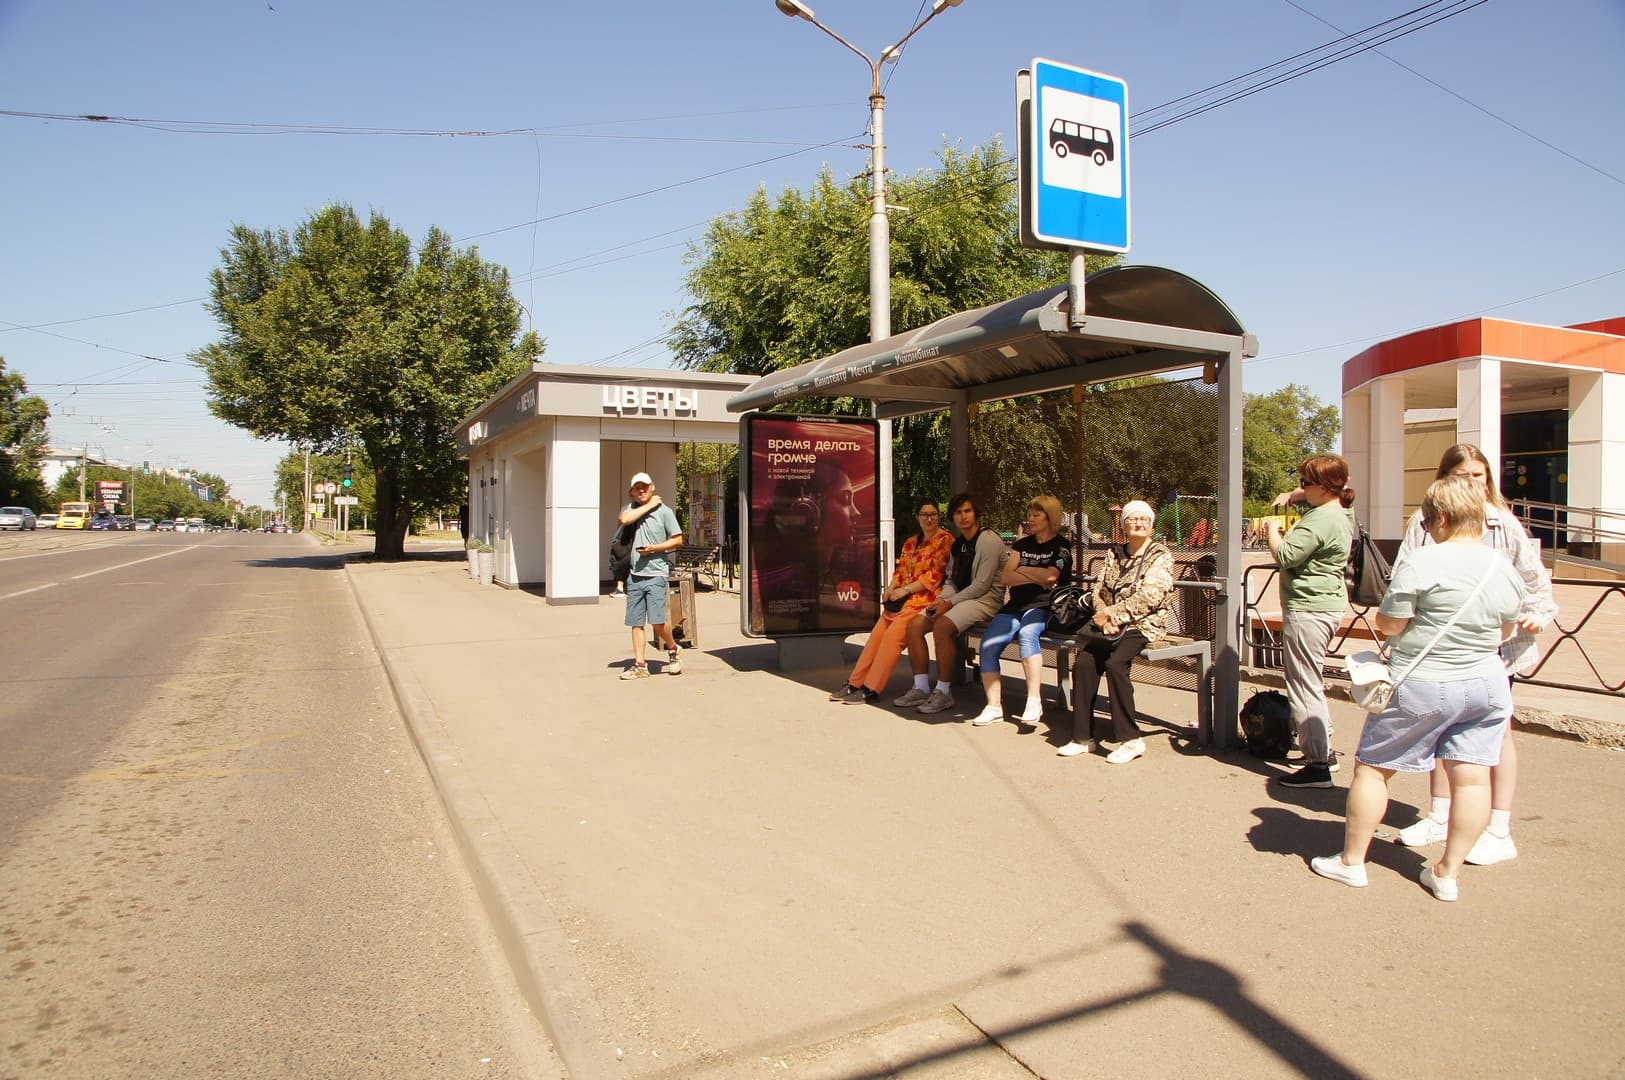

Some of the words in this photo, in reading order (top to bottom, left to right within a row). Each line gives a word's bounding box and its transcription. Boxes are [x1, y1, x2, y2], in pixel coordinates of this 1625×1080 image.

[814, 371, 848, 388] Кинотеатр
[848, 359, 876, 377] "Мечта"
[894, 346, 940, 366] Учкомбинат
[603, 384, 698, 412] ЦВЕТЫ
[768, 439, 811, 452] время
[814, 441, 861, 452] делать
[768, 453, 817, 466] громче
[836, 586, 860, 601] wb
